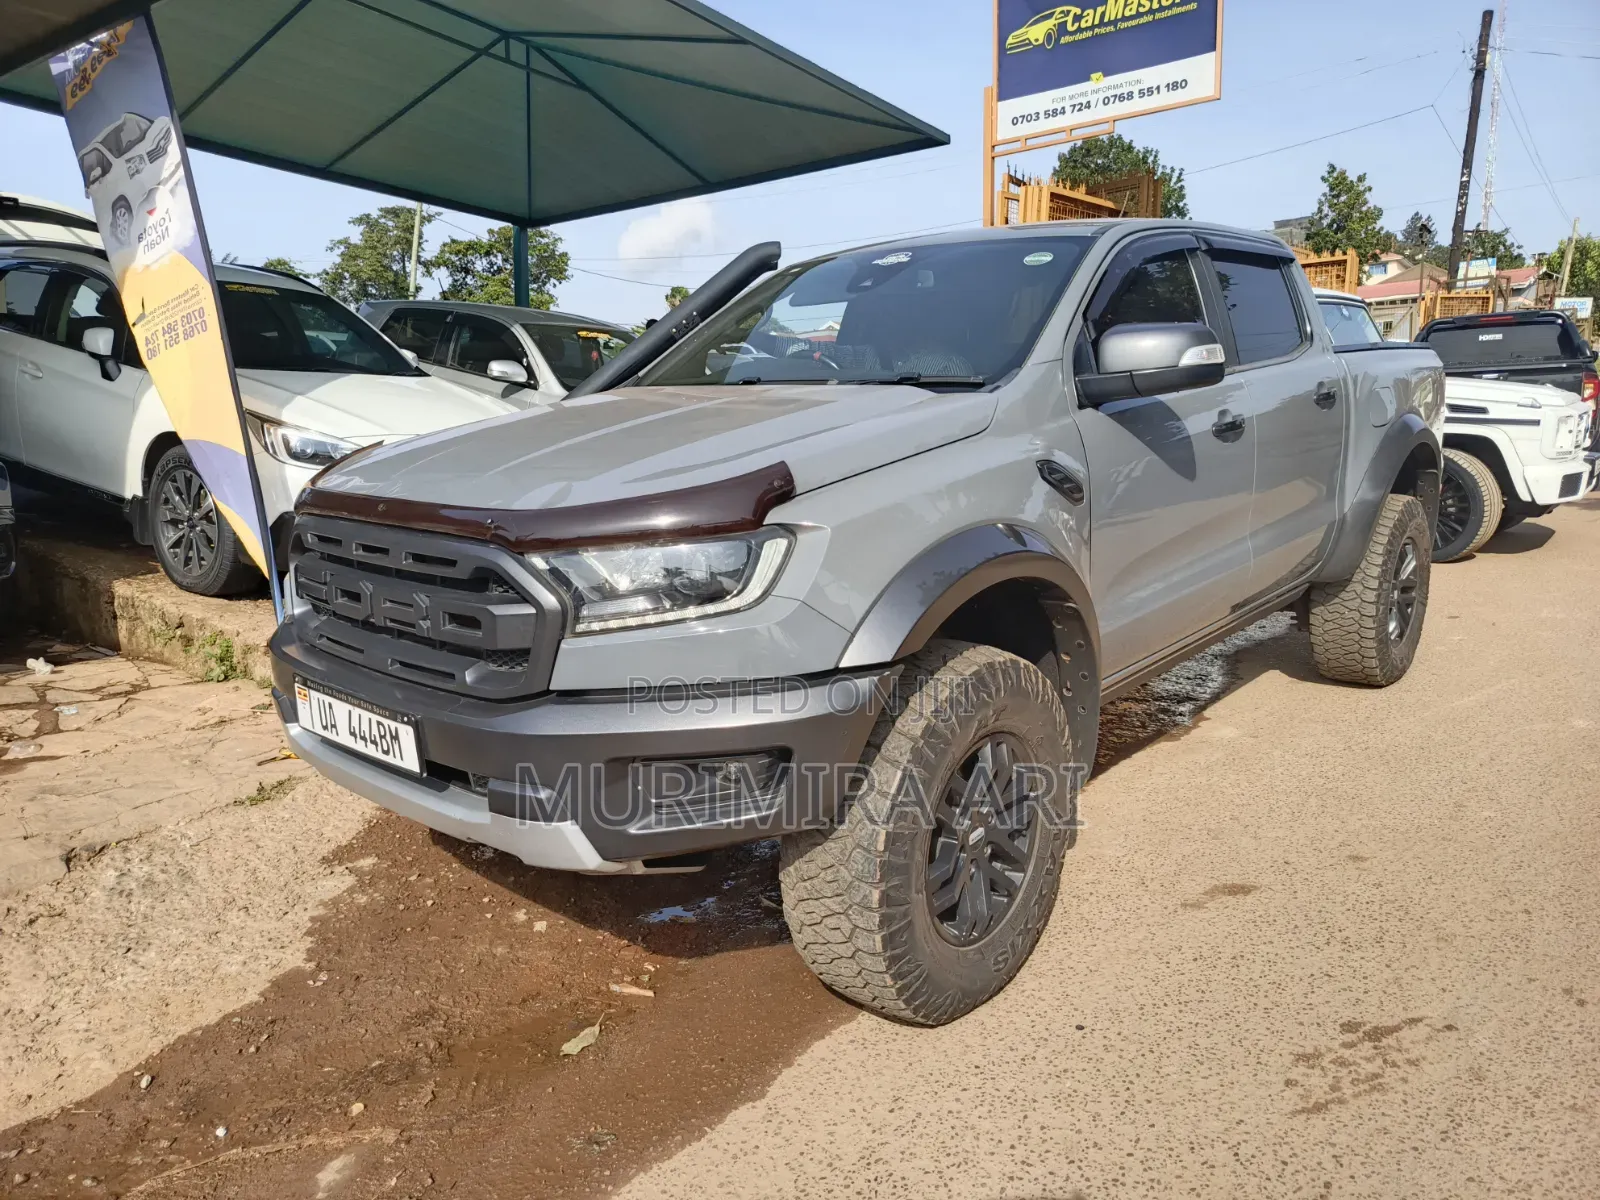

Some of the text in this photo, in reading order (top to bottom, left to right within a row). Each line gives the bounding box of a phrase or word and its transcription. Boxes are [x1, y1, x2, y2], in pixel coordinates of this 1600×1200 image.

[1060, 2, 1198, 44] Affordable Prices, Favourable Installments
[1067, 0, 1181, 31] CarMaste
[1011, 112, 1040, 126] 0703
[1043, 106, 1067, 120] 584
[1069, 101, 1092, 114] 724
[1102, 92, 1134, 107] 0768
[1138, 85, 1161, 99] 551
[1164, 78, 1188, 92] 180
[1052, 79, 1144, 104] FOR MORE INFORMATION:
[297, 564, 493, 649] FORD
[317, 697, 404, 762] UA 444BM
